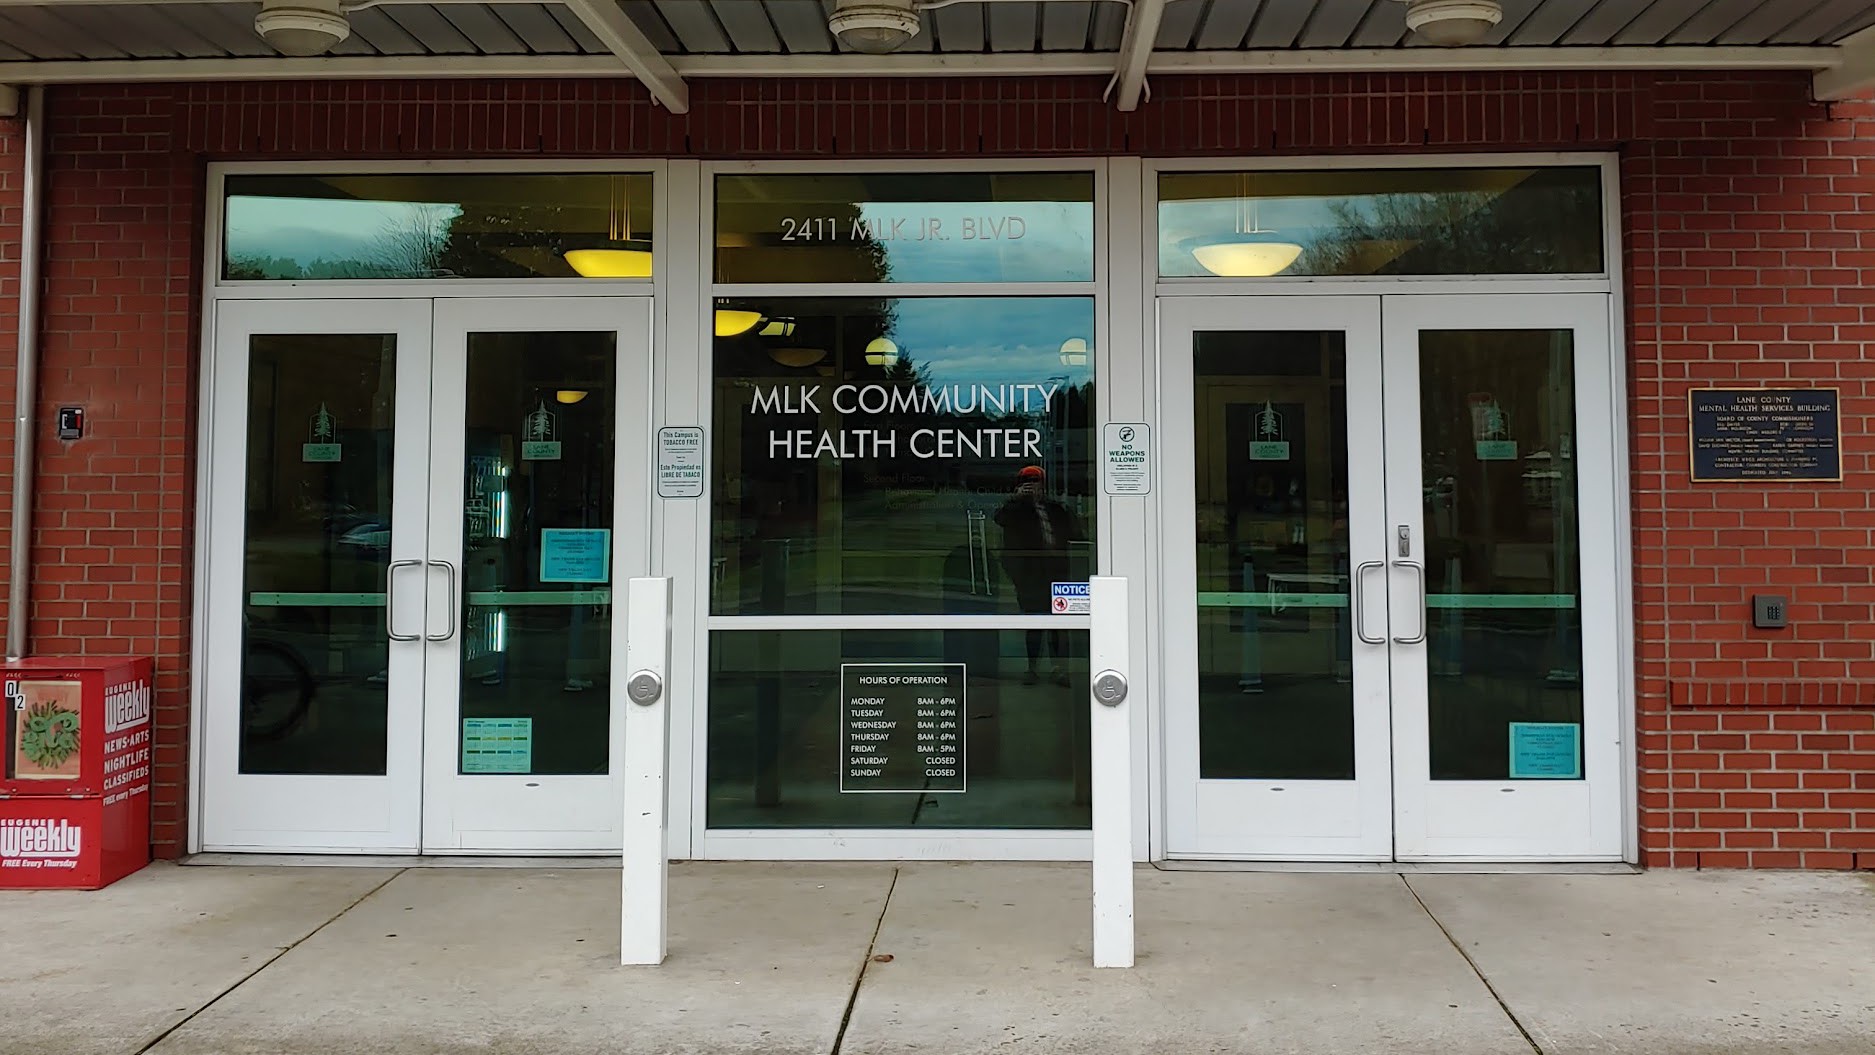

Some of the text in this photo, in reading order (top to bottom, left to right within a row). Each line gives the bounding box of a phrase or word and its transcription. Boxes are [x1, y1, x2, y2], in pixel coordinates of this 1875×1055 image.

[780, 216, 1026, 241] 2411 MLK JR. BLVD
[750, 383, 1059, 414] MLK COMMUNITY
[1736, 396, 1757, 404] LANE
[1698, 404, 1831, 412] MENTAL HEALTH SERVICES BUILDING
[769, 428, 1043, 458] HEALTH CENTER
[1053, 584, 1091, 595] NOTICE
[859, 676, 948, 684] HOURS OF OPERATION
[17, 694, 24, 710] 2
[850, 697, 885, 705] MONDAY
[917, 697, 934, 705] 8AM
[940, 697, 956, 705] 6PM
[850, 709, 884, 717] TUESDAY
[917, 709, 934, 717] 8AM
[940, 709, 956, 717] 6PM
[850, 721, 897, 729] WEDNESDAY
[917, 721, 934, 729] 8AM
[940, 721, 956, 729] 6PM
[850, 733, 890, 741] THURSDAY
[917, 733, 934, 741] 8AM
[940, 733, 956, 741] 6PM
[850, 745, 877, 753] FRIDAY
[917, 745, 934, 753] 8AM
[940, 745, 956, 753] 5PM
[103, 747, 150, 775] NIGHTLIFE
[850, 757, 956, 765] SATURDAY CLOSED
[850, 769, 956, 777] SUNDAY CLOSED
[103, 764, 150, 791] CLASSIFIEDS
[102, 793, 116, 806] FREE
[128, 783, 150, 797] Thursday
[0, 819, 47, 827] EUGENE
[2, 859, 78, 869] FREE Every Thursday
